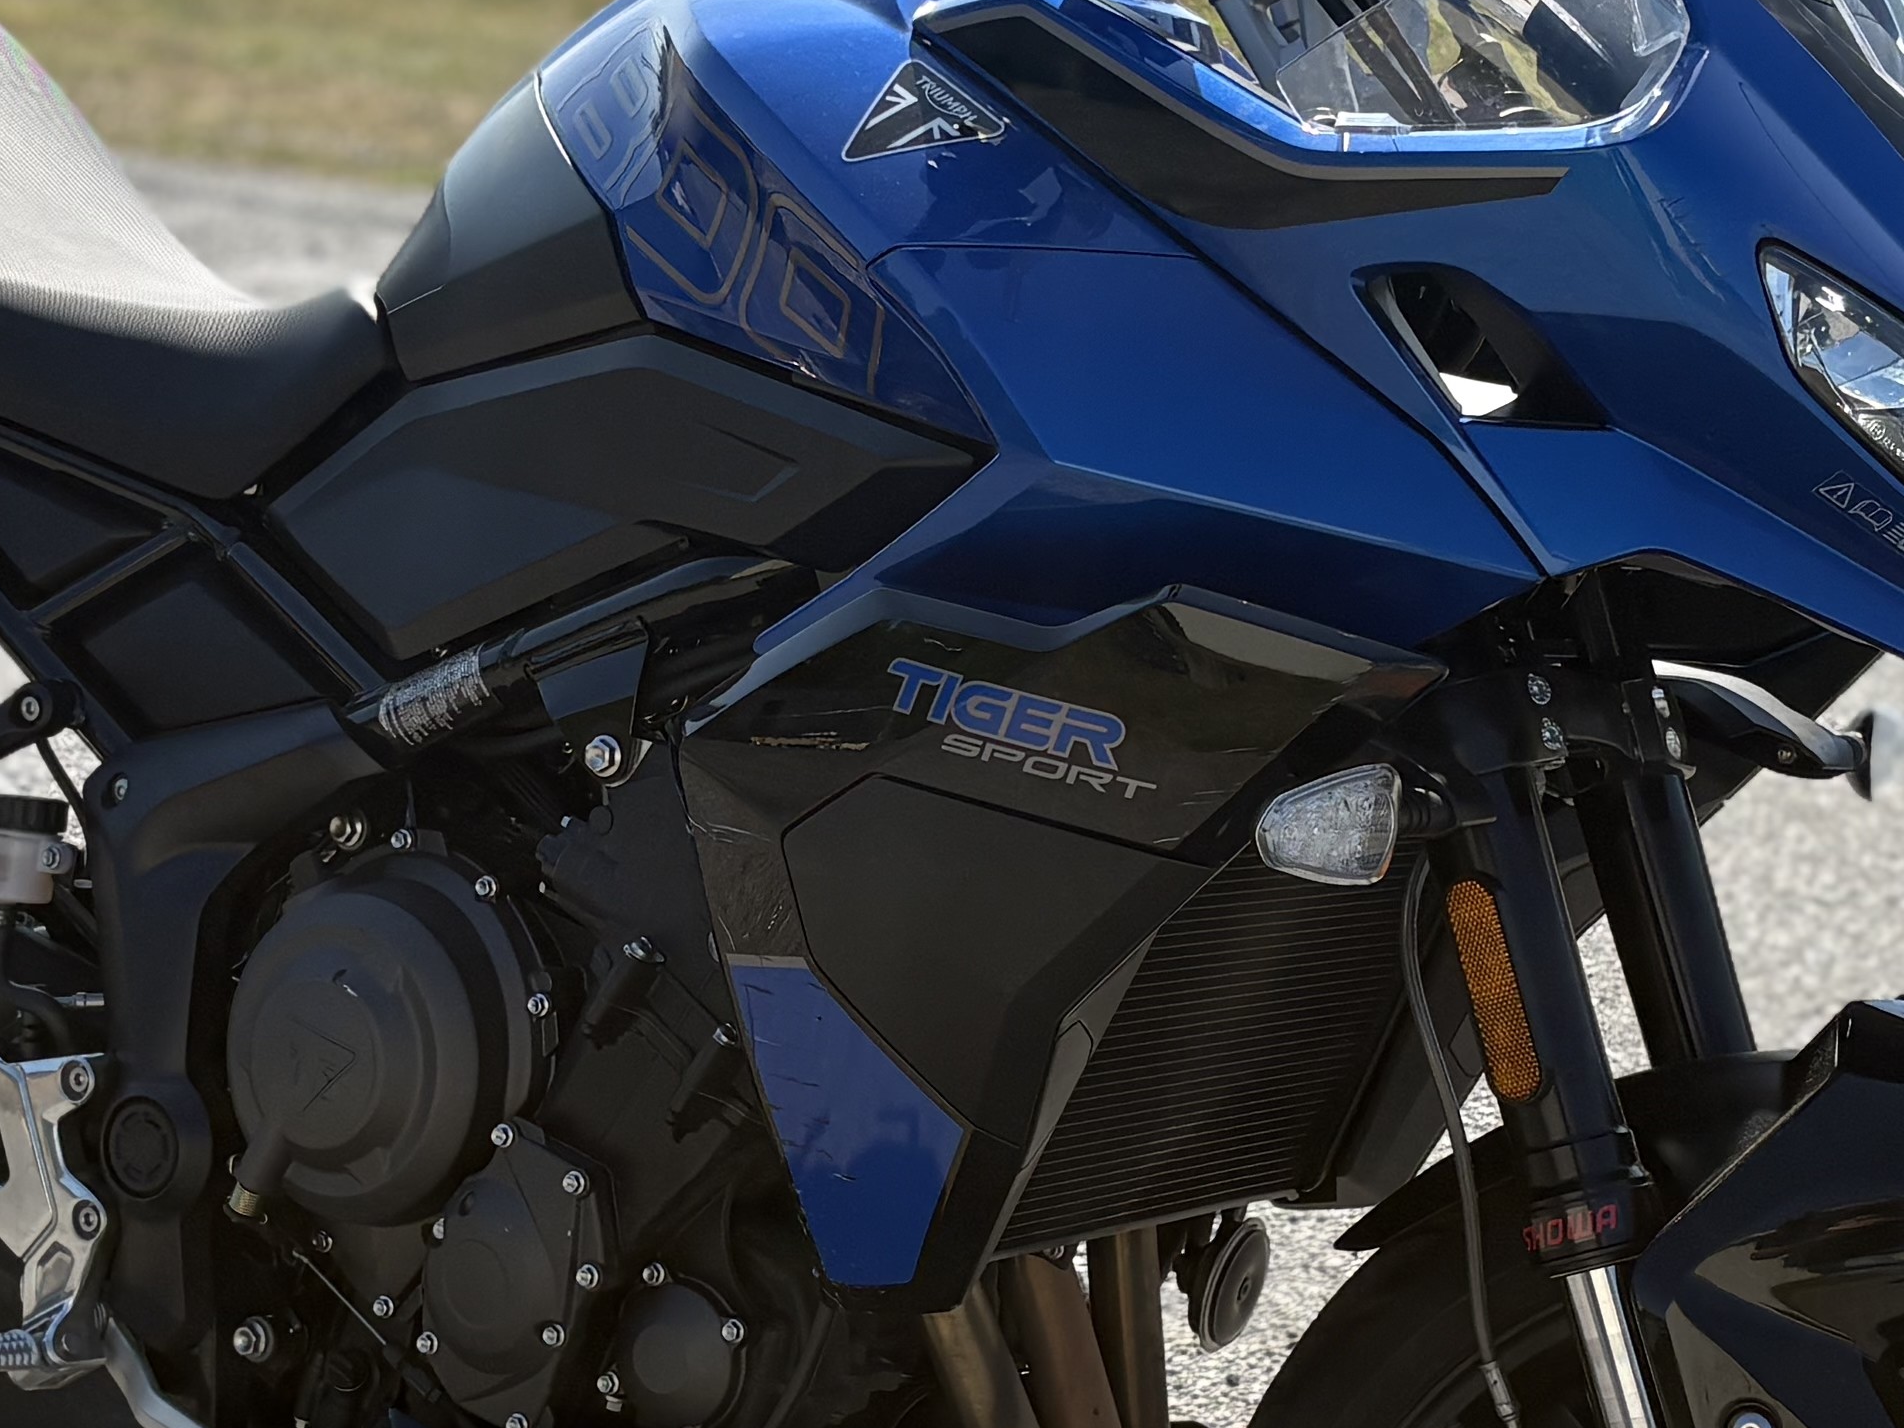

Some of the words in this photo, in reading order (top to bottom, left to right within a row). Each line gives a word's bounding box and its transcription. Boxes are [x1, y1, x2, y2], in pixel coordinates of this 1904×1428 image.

[915, 74, 979, 123] TRIUMPH
[887, 657, 1126, 771] TIGER
[941, 733, 1157, 800] SPORT
[1522, 1203, 1618, 1252] SHOWA
